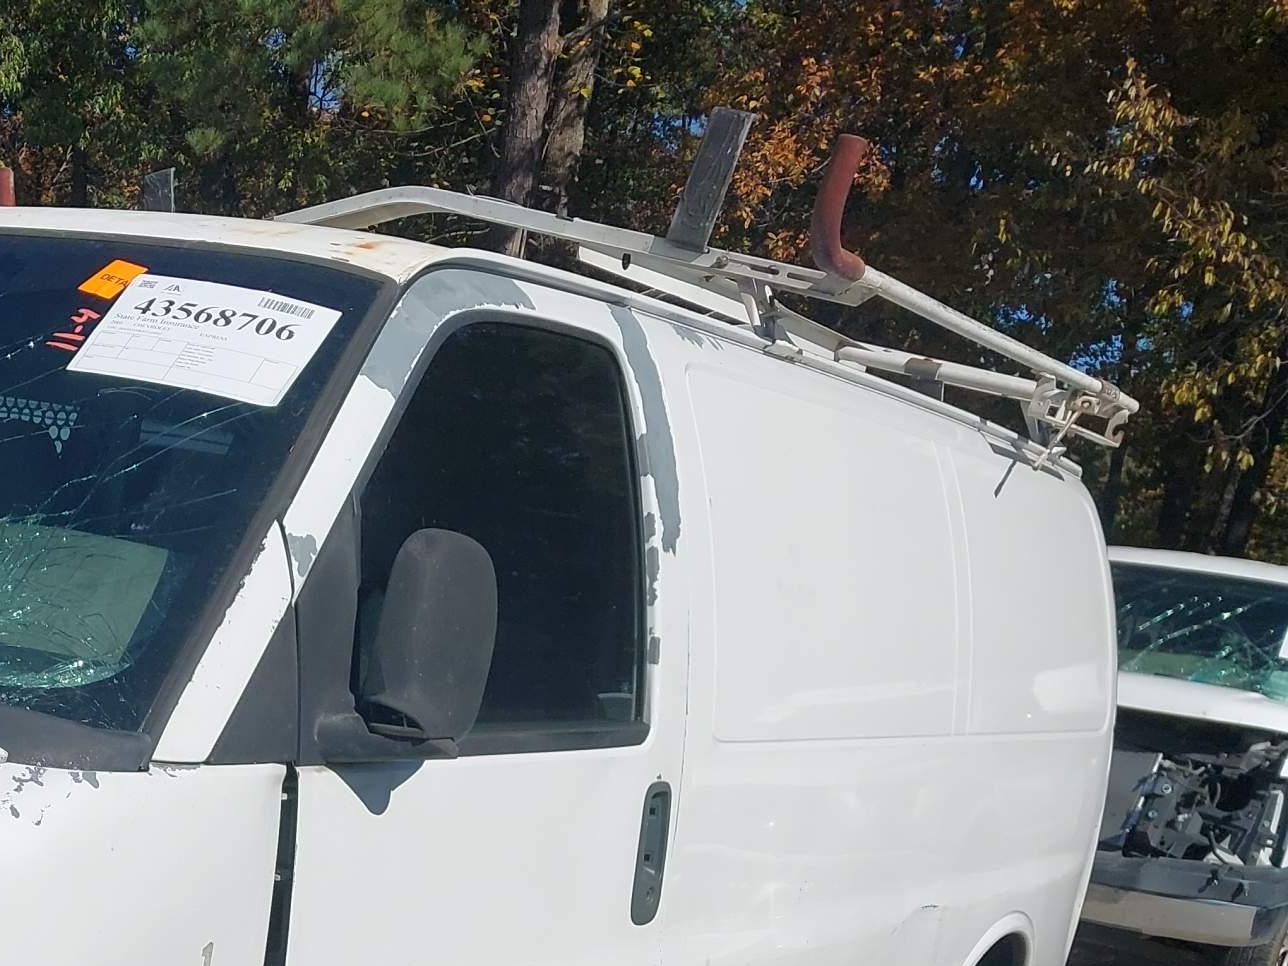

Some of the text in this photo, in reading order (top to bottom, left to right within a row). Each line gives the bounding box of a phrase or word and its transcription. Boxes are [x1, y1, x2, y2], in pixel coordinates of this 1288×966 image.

[114, 312, 200, 330] State Farm Insurance
[133, 296, 303, 341] 43568706
